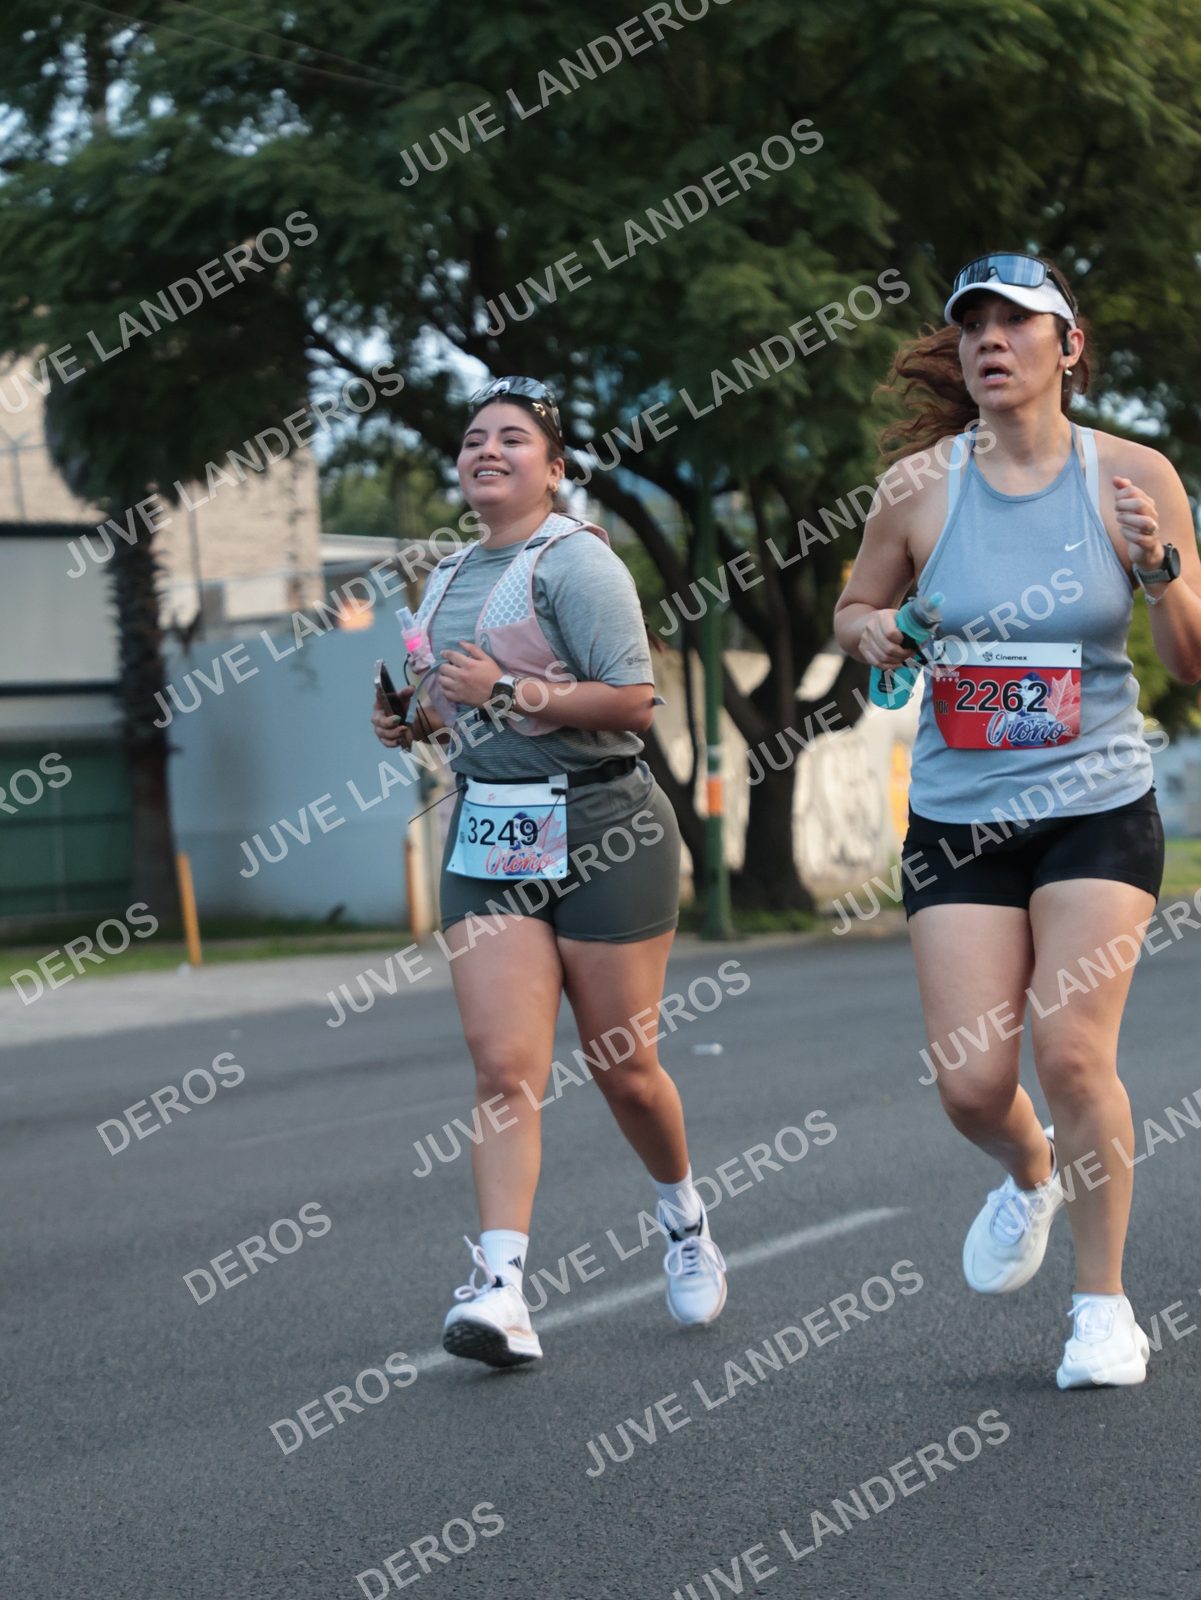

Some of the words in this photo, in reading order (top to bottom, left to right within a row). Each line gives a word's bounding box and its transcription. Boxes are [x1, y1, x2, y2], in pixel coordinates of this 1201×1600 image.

[995, 652, 1028, 661] Cinemex
[956, 679, 1048, 713] 2262
[468, 816, 539, 846] 3249
